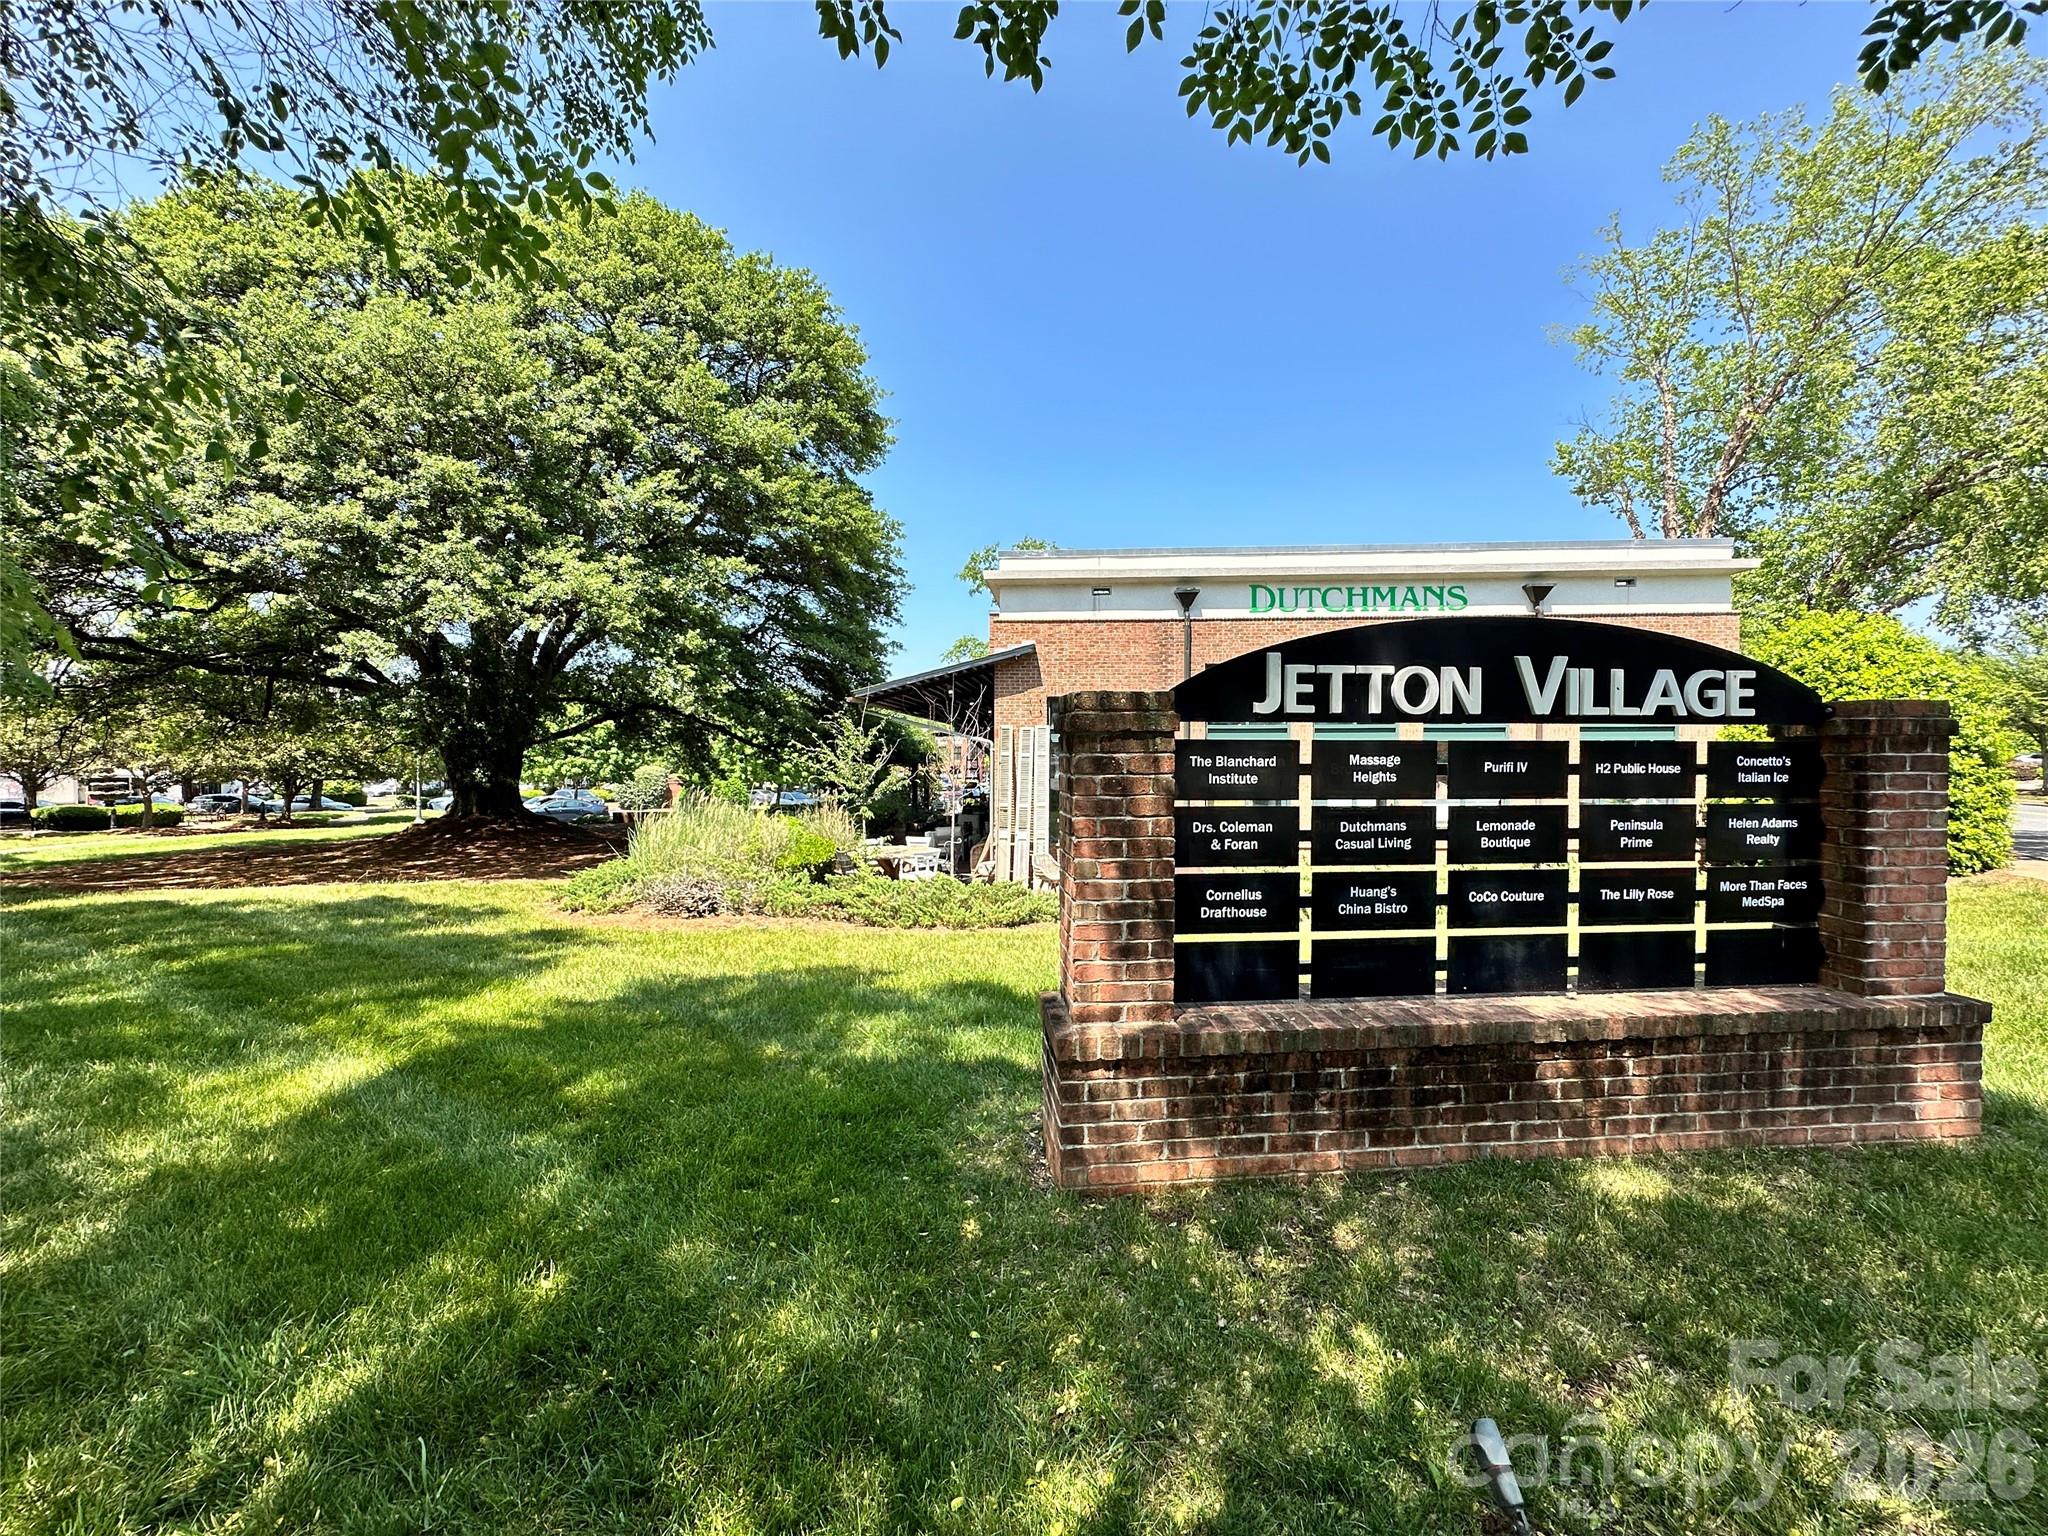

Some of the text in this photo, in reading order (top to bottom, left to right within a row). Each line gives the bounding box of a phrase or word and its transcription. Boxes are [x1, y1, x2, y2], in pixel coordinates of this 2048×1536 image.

[1249, 584, 1469, 613] DUTCHMANS
[1252, 652, 1756, 717] JETTON VILLAGE
[1189, 755, 1277, 768] The Blanchard
[1349, 753, 1401, 768] Massage
[1484, 761, 1529, 773] Purifi IV
[1736, 755, 1792, 767] Concetto's
[1595, 762, 1682, 774] H2 Public House
[1208, 772, 1259, 785] Institute
[1353, 770, 1398, 785] Heights
[1737, 771, 1790, 783] Italian Ice
[1192, 820, 1273, 834] Drs. Coleman
[1340, 820, 1407, 833] Dutchmans
[1476, 819, 1536, 832] Lemonade
[1610, 818, 1664, 831] Peninsula
[1728, 817, 1799, 829] Helen Adams
[1210, 838, 1258, 851] & Foran
[1335, 836, 1412, 851] Casual Living
[1480, 836, 1531, 850] Boutique
[1620, 836, 1654, 849] Prime
[1746, 833, 1781, 847] Realty
[1350, 885, 1398, 900] Huang's
[1719, 879, 1808, 893] More Than Faces
[1205, 888, 1263, 901] Cornelius
[1468, 890, 1545, 903] CoCo Couture
[1599, 888, 1675, 902] The Lilly Rose
[1338, 902, 1408, 915] China Bistro
[1741, 895, 1785, 909] MedSpa
[1200, 906, 1268, 919] Drafthouse
